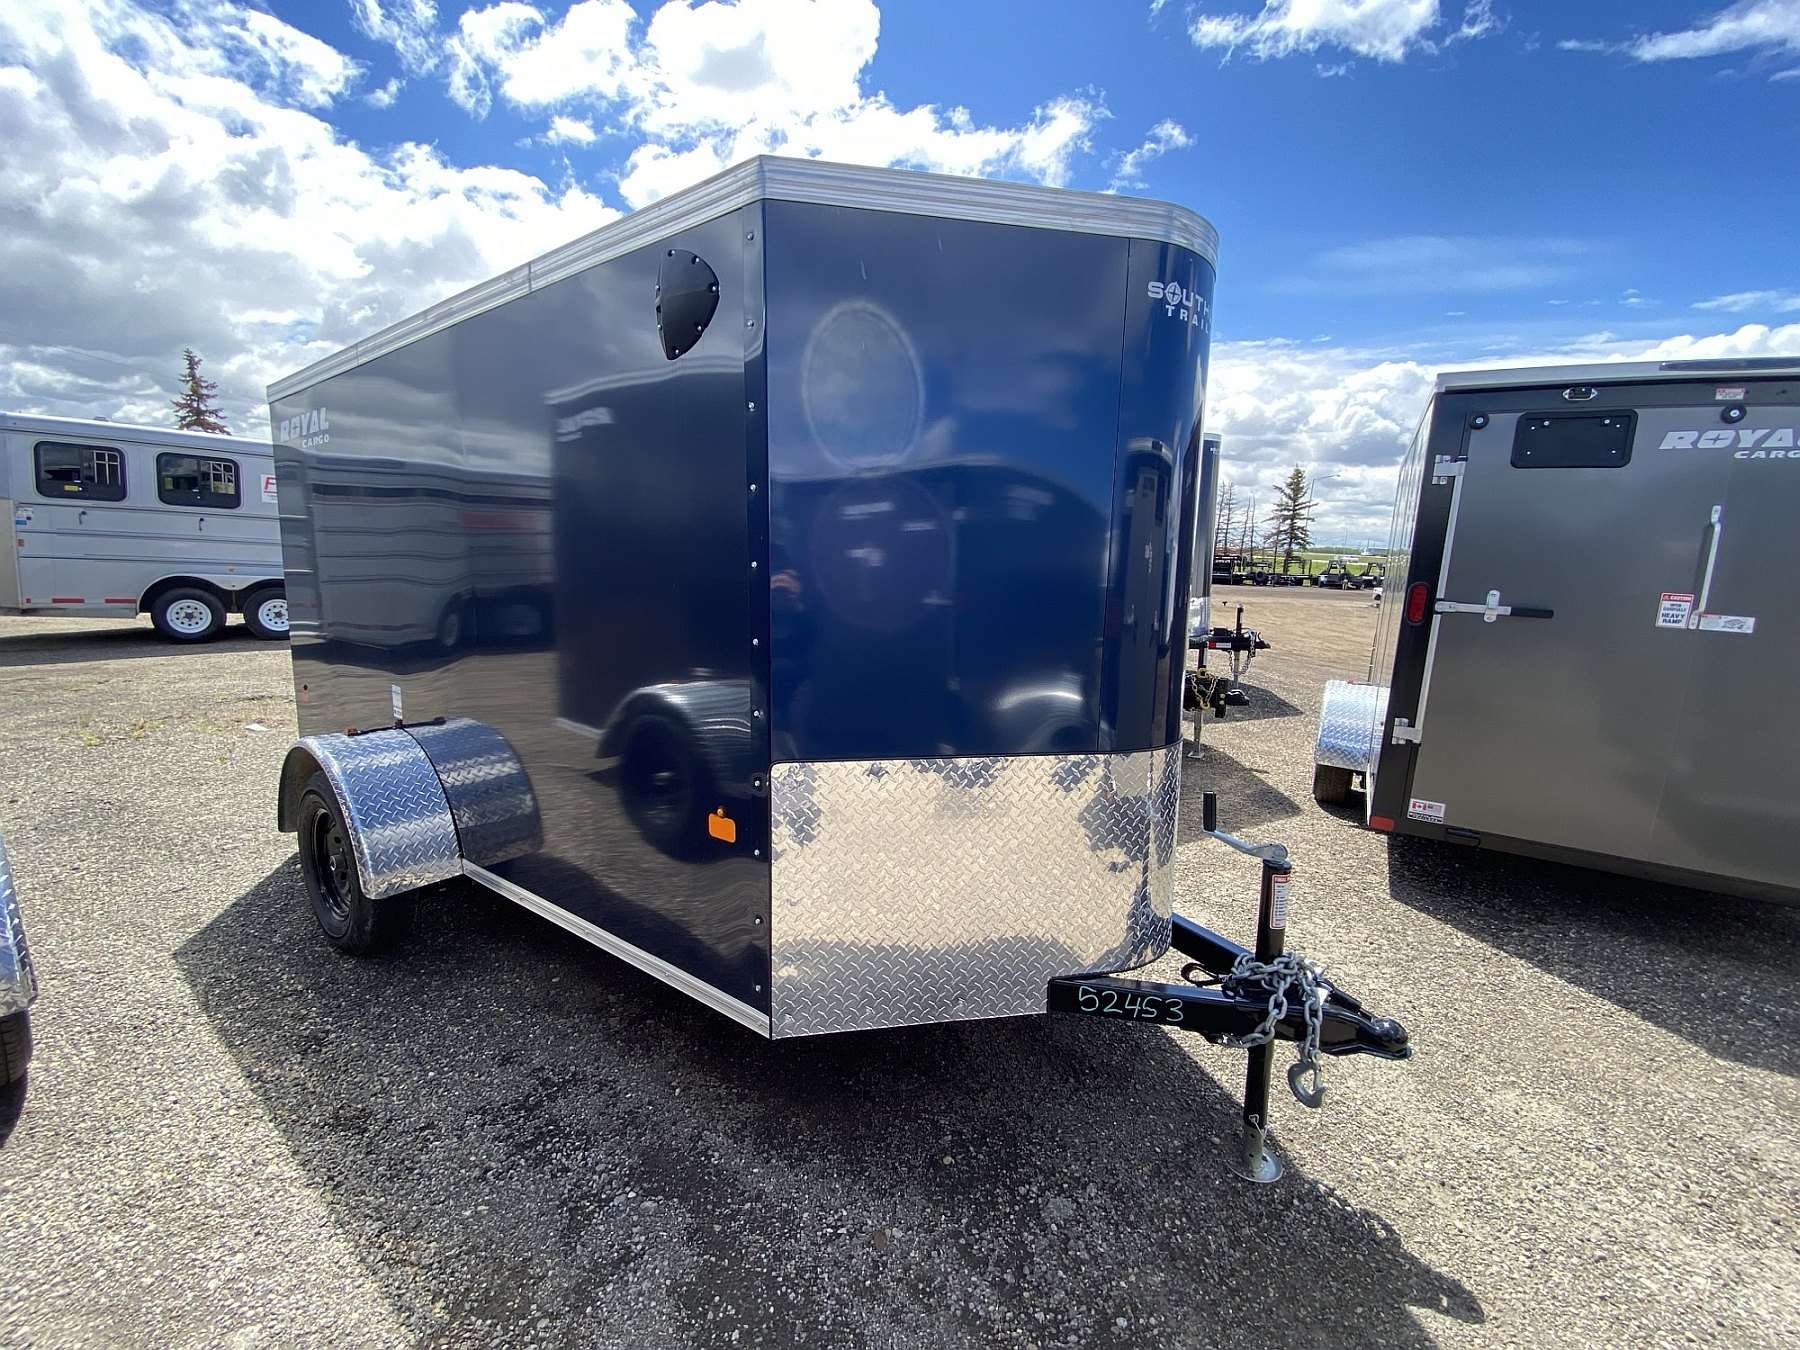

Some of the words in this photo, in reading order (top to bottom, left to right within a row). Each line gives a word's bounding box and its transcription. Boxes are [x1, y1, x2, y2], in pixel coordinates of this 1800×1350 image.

[1147, 281, 1209, 316] SOUTH
[1165, 304, 1209, 334] TRAIL
[280, 407, 329, 443] ROYAL
[302, 433, 330, 449] CARGO
[1658, 428, 1800, 450] ROYA
[1078, 985, 1184, 1022] 52453
